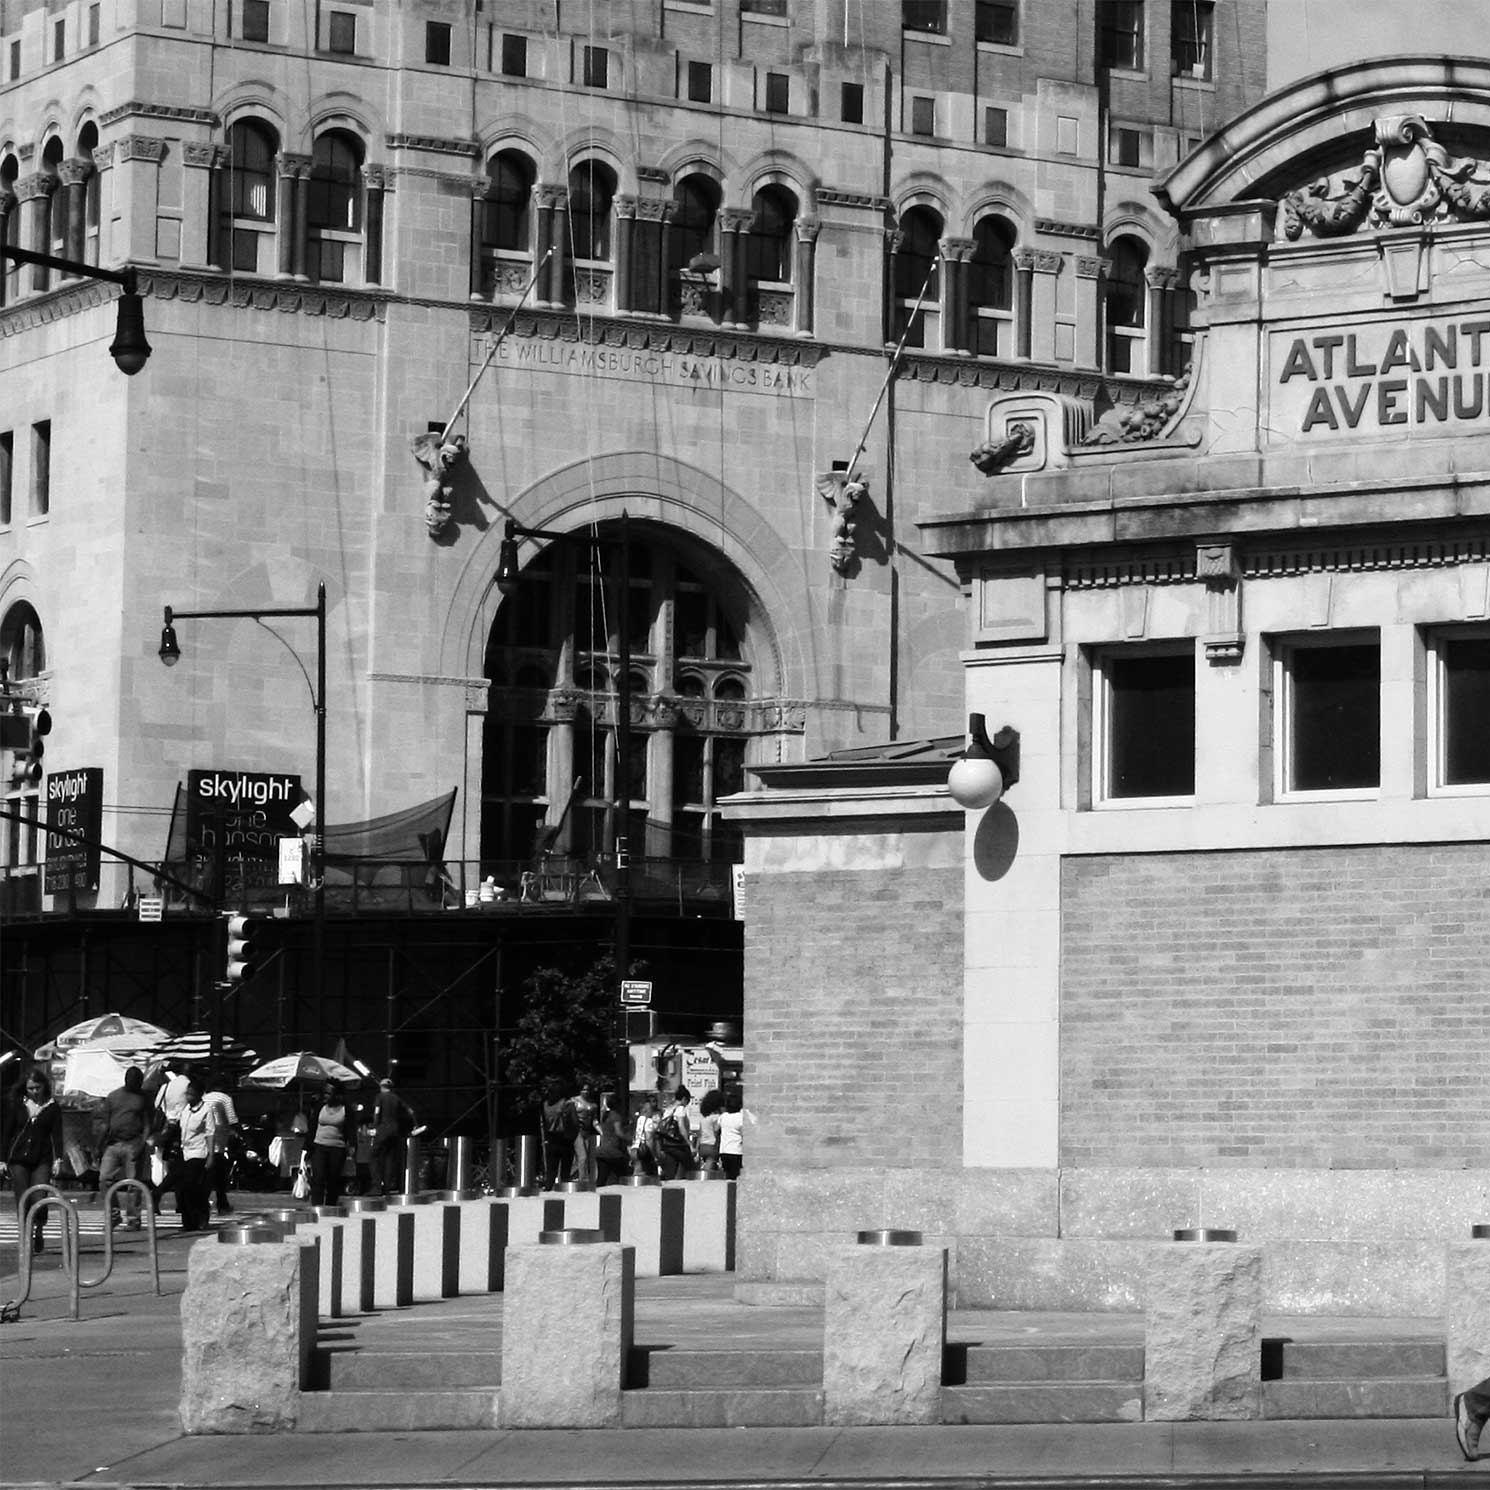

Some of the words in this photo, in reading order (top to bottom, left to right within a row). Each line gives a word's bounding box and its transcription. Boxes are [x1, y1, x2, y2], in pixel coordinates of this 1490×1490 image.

[472, 338, 509, 360] THE
[514, 343, 673, 377] WILLIAMSBURGH
[679, 360, 757, 386] SAVINGS
[763, 369, 811, 391] BANK
[49, 771, 88, 803] skylight
[199, 773, 293, 806] skylight
[57, 807, 77, 827] one
